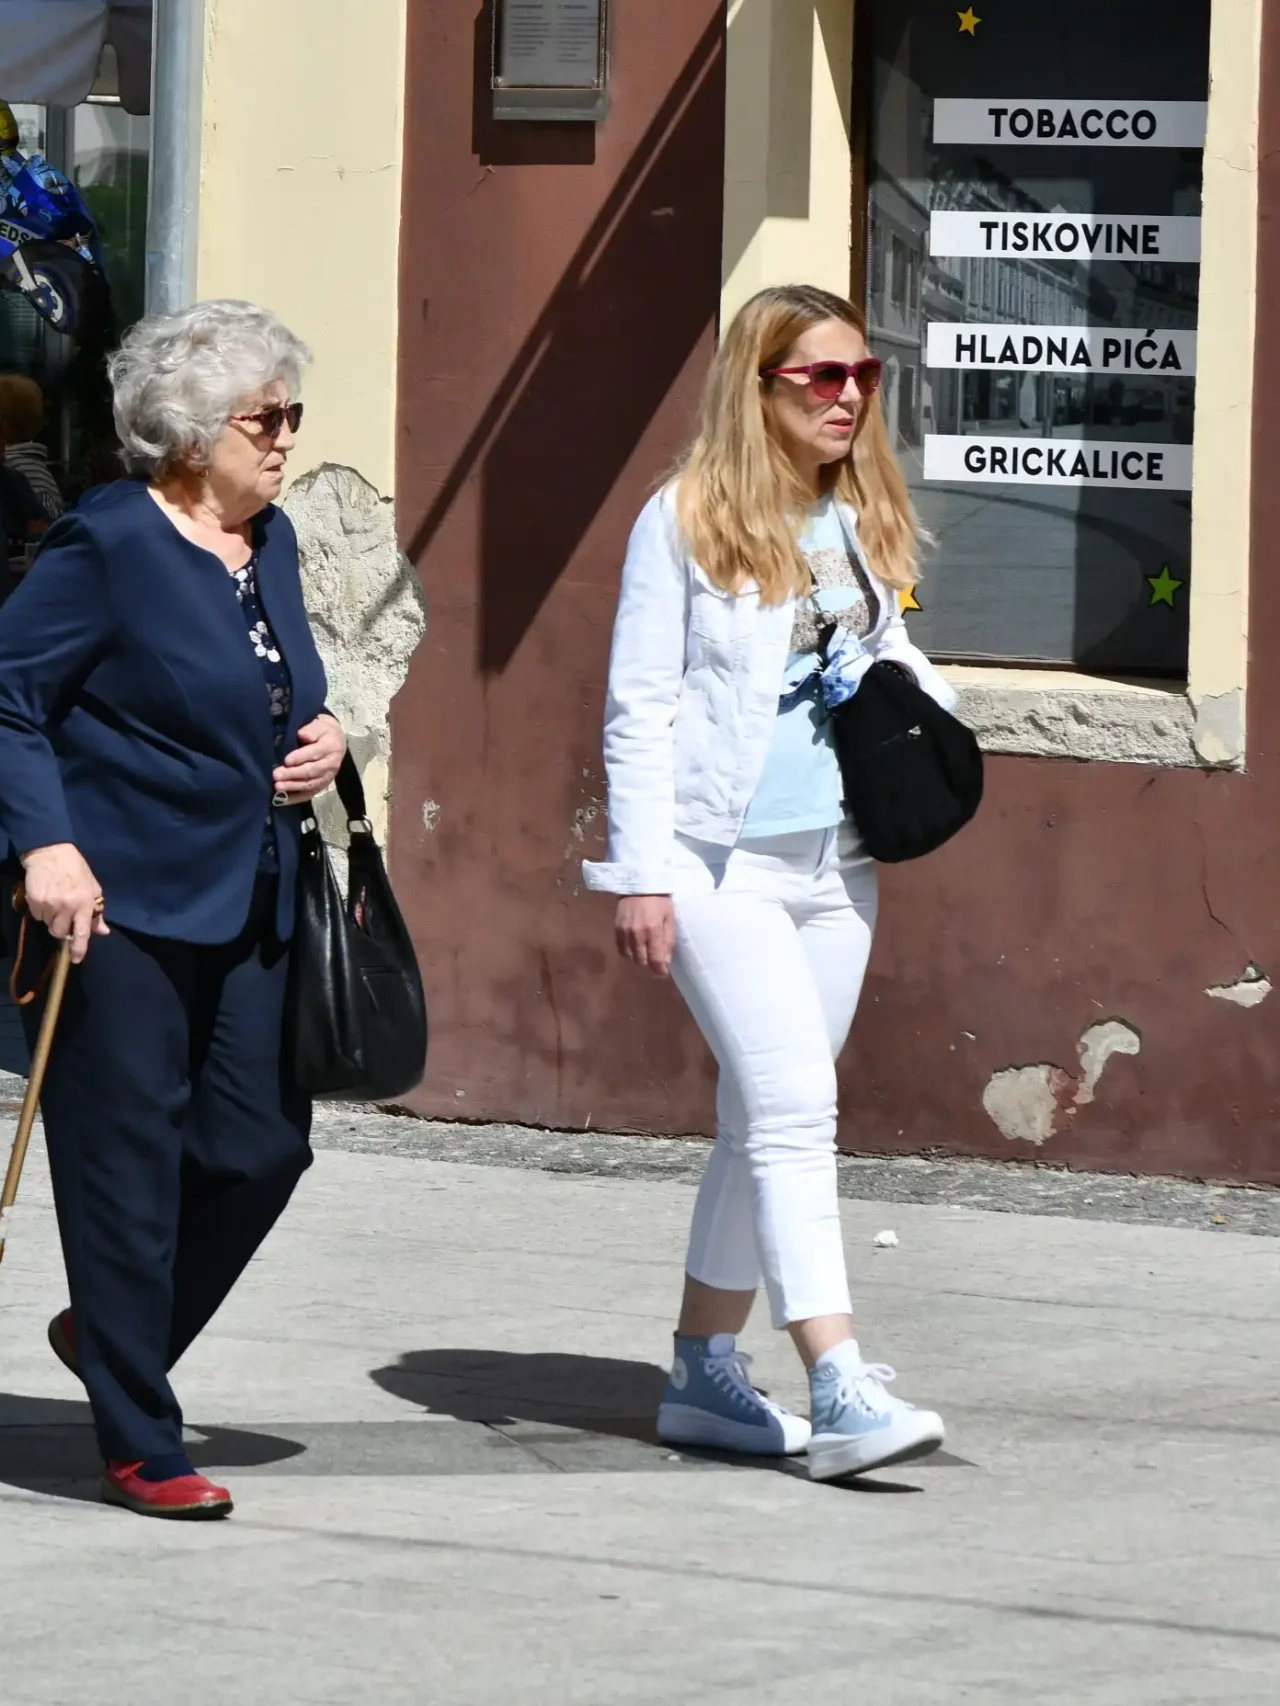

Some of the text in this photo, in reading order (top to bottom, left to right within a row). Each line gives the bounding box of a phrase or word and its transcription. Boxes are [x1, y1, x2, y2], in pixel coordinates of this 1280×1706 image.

[988, 108, 1157, 140] TOBACCO
[980, 221, 1160, 255] TISKOVINE
[955, 329, 1182, 371] HLADNA PIĆA
[964, 445, 1164, 482] GRICKALICE
